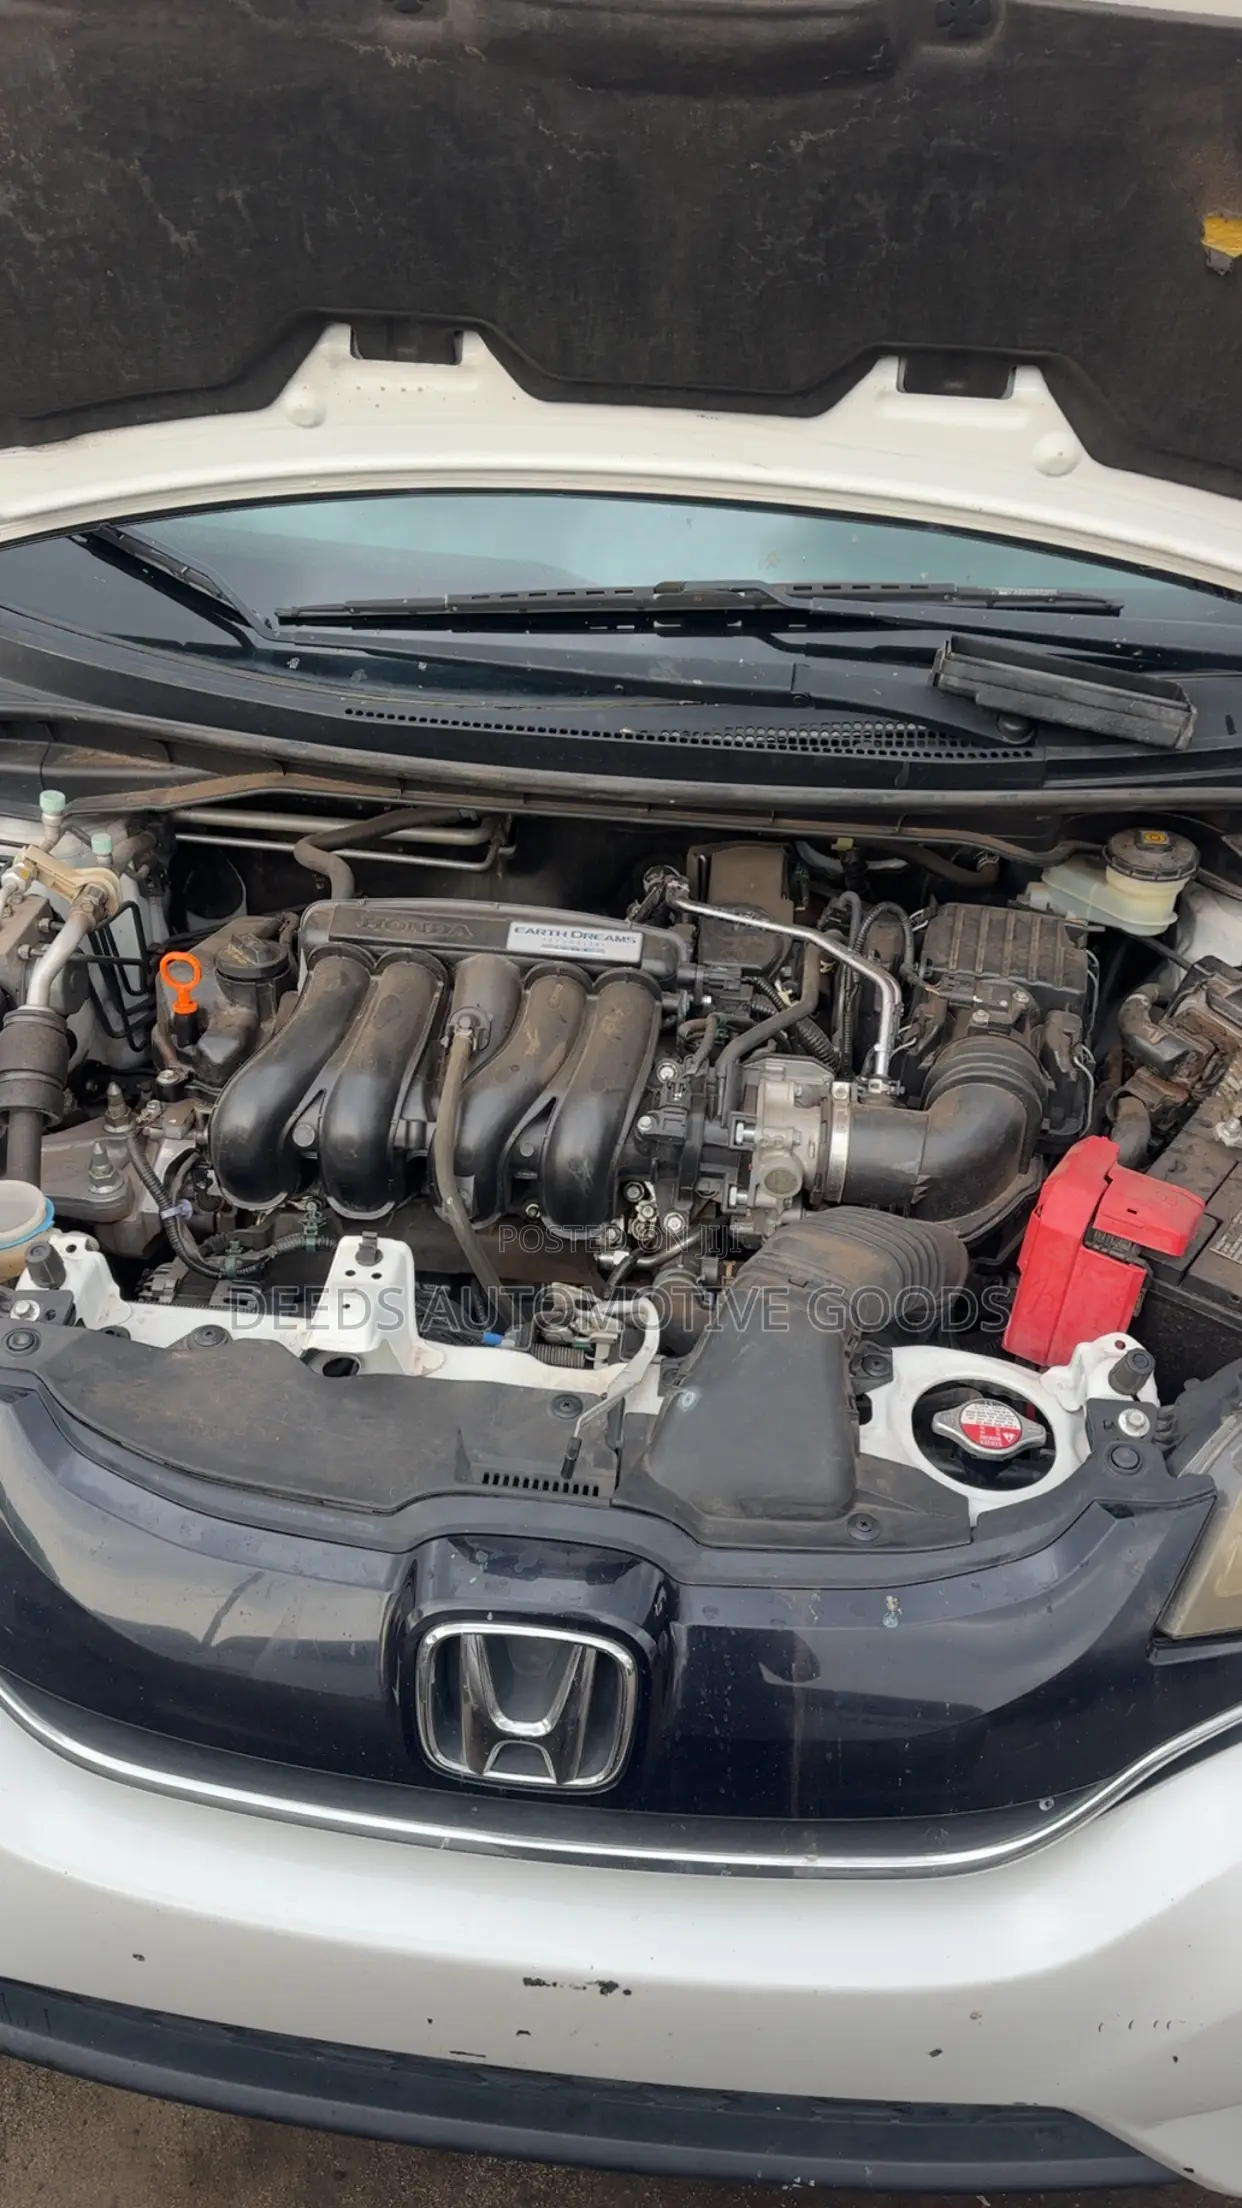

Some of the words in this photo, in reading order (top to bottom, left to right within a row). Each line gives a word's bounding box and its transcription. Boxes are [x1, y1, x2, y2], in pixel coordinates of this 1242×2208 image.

[356, 914, 475, 938] HONDA
[514, 926, 568, 938] EARTH
[571, 930, 637, 944] DREAMS
